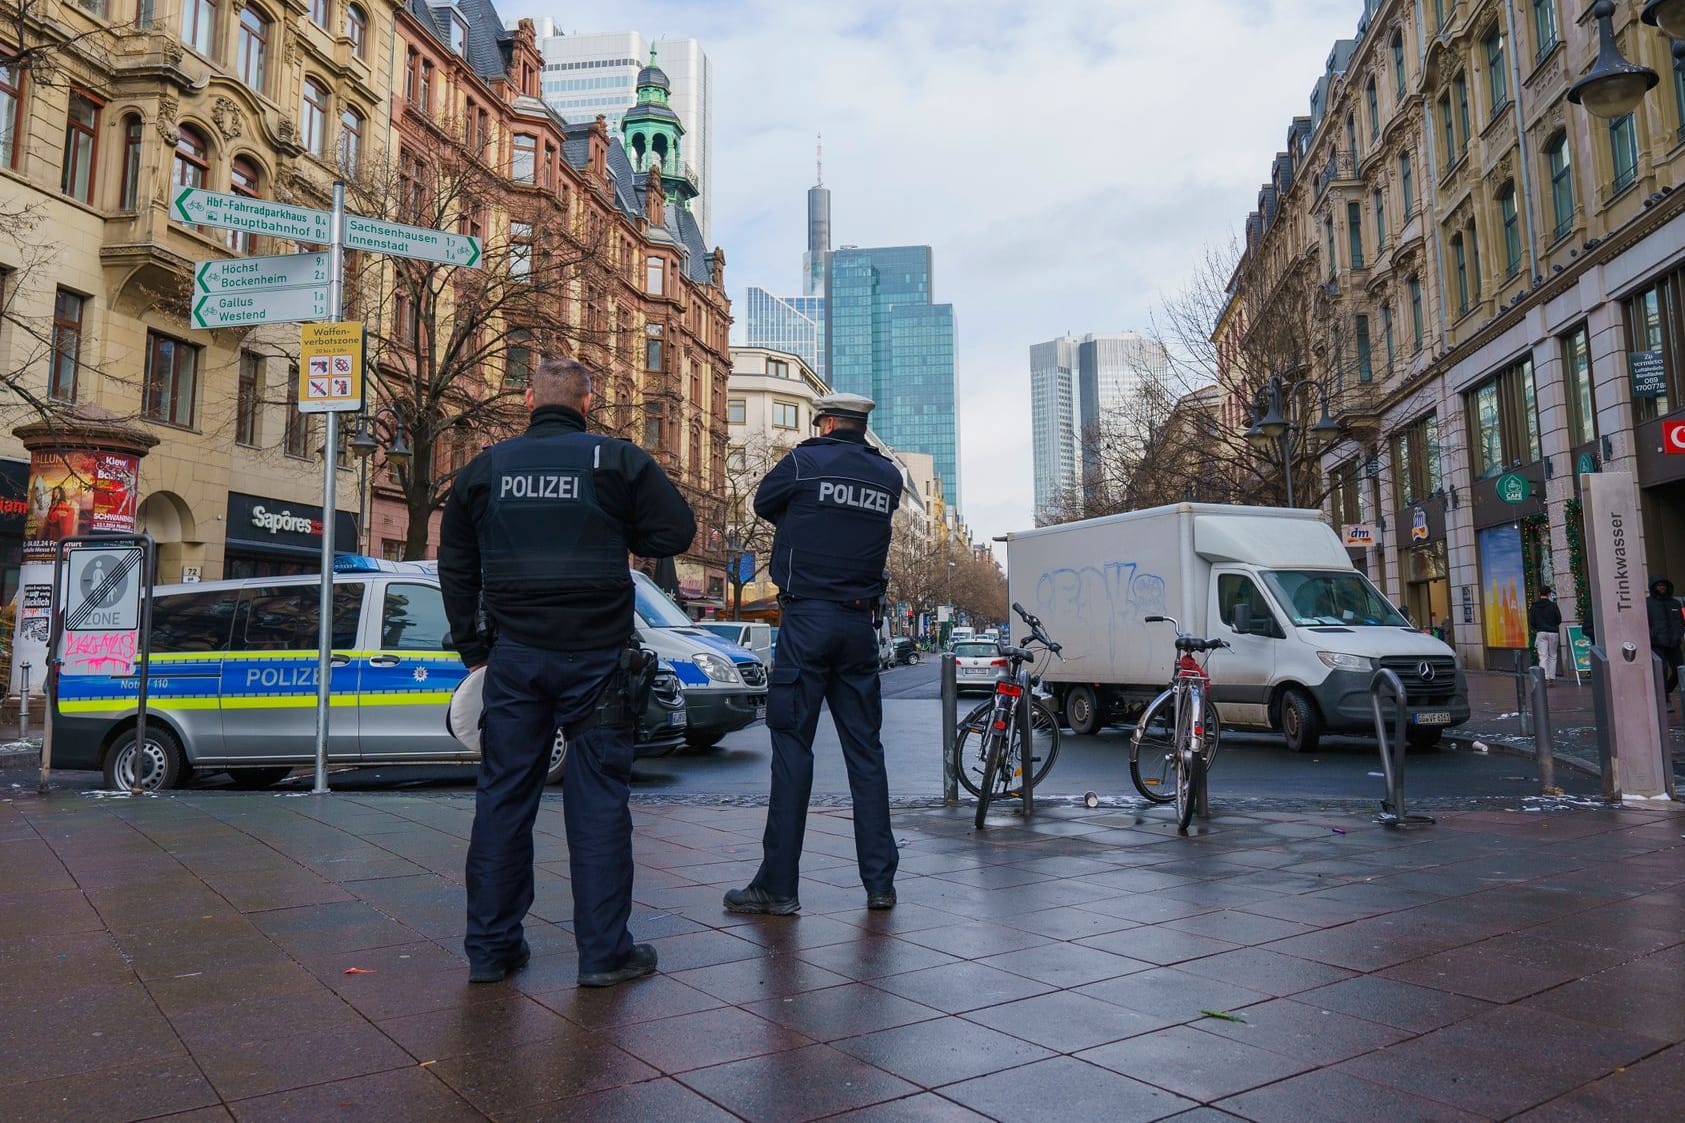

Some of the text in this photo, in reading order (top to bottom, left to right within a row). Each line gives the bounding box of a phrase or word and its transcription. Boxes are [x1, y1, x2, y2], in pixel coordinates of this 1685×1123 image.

[206, 196, 308, 223] Hbf-Fahrradparkhaus
[223, 213, 310, 236] Hauptbahnhof
[350, 220, 438, 244] Sachsenhausen
[349, 233, 409, 252] Innenstadt
[222, 263, 259, 274] Höchst
[221, 273, 287, 288] Bockenheim
[219, 298, 254, 308] Gallus
[219, 309, 266, 321] Westend
[313, 328, 350, 336] Waffen-
[304, 337, 360, 345] verbotszone
[1644, 376, 1659, 384] 069
[500, 475, 579, 498] POLIZEI
[818, 481, 890, 514] POLIZEI
[252, 505, 312, 533] Sapôres
[1351, 528, 1369, 538] dm
[1610, 512, 1632, 613] Trinkwasser
[187, 567, 197, 577] 72
[84, 612, 121, 625] ZONE
[153, 679, 168, 688] 110
[246, 667, 333, 687] POLIZE
